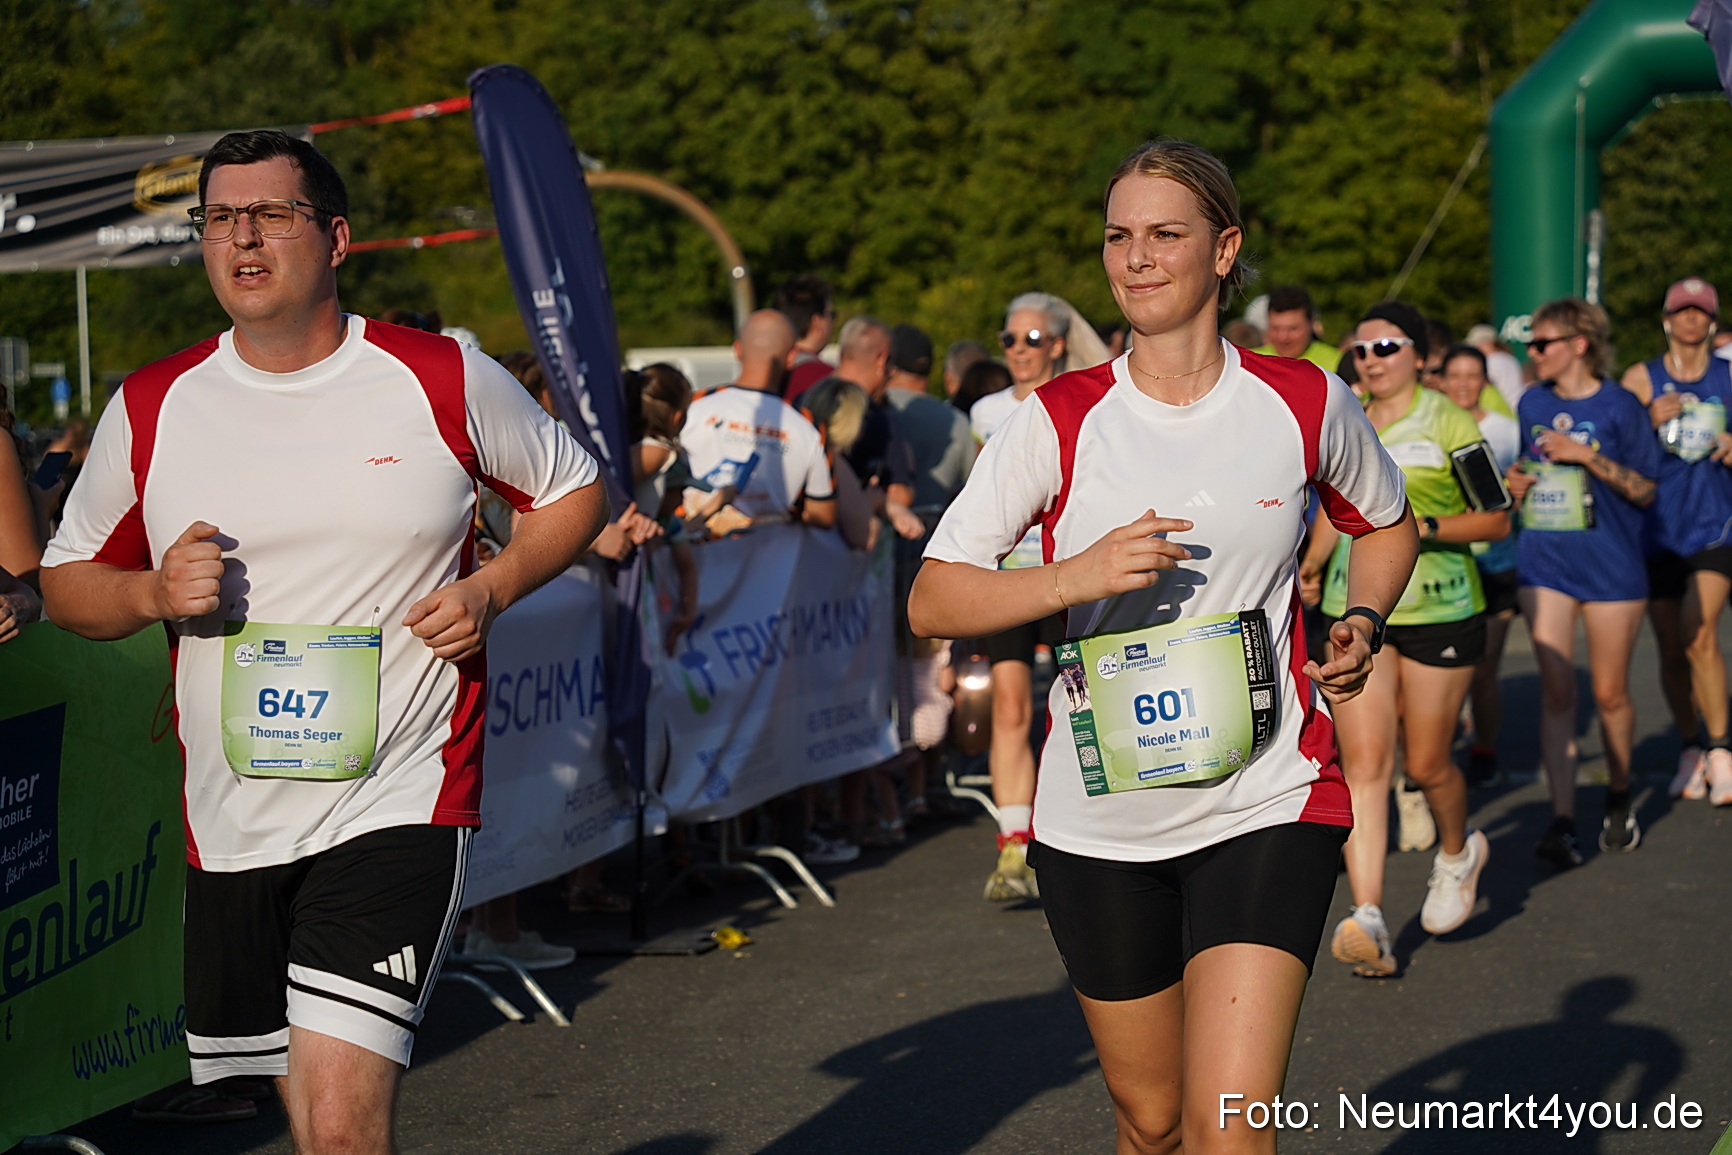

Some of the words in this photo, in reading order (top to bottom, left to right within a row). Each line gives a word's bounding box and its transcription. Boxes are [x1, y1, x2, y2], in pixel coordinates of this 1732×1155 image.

[375, 455, 394, 466] DEHN
[1263, 498, 1279, 508] DEHN
[1242, 620, 1255, 659] RABATT
[1250, 620, 1261, 648] OUTLET
[256, 654, 303, 663] Firmenlauf
[1060, 650, 1078, 661] AOK
[1120, 653, 1166, 671] Firmenlauf
[1254, 648, 1264, 680] FACTORY
[1138, 662, 1167, 673] neumarkt
[1249, 668, 1257, 682] 20
[258, 688, 329, 719] 647
[1133, 688, 1196, 725] 601
[248, 726, 300, 740] Thomas
[303, 728, 343, 743] Seger
[1137, 732, 1177, 748] Nicole
[1180, 726, 1210, 742] Mall
[1254, 713, 1267, 755] HILTL
[252, 760, 300, 768] firmenlauf.bayern
[1140, 766, 1183, 780] firmenlauf.bayern
[0, 773, 40, 810] her
[1, 845, 16, 864] das
[3, 820, 161, 994] enlauf
